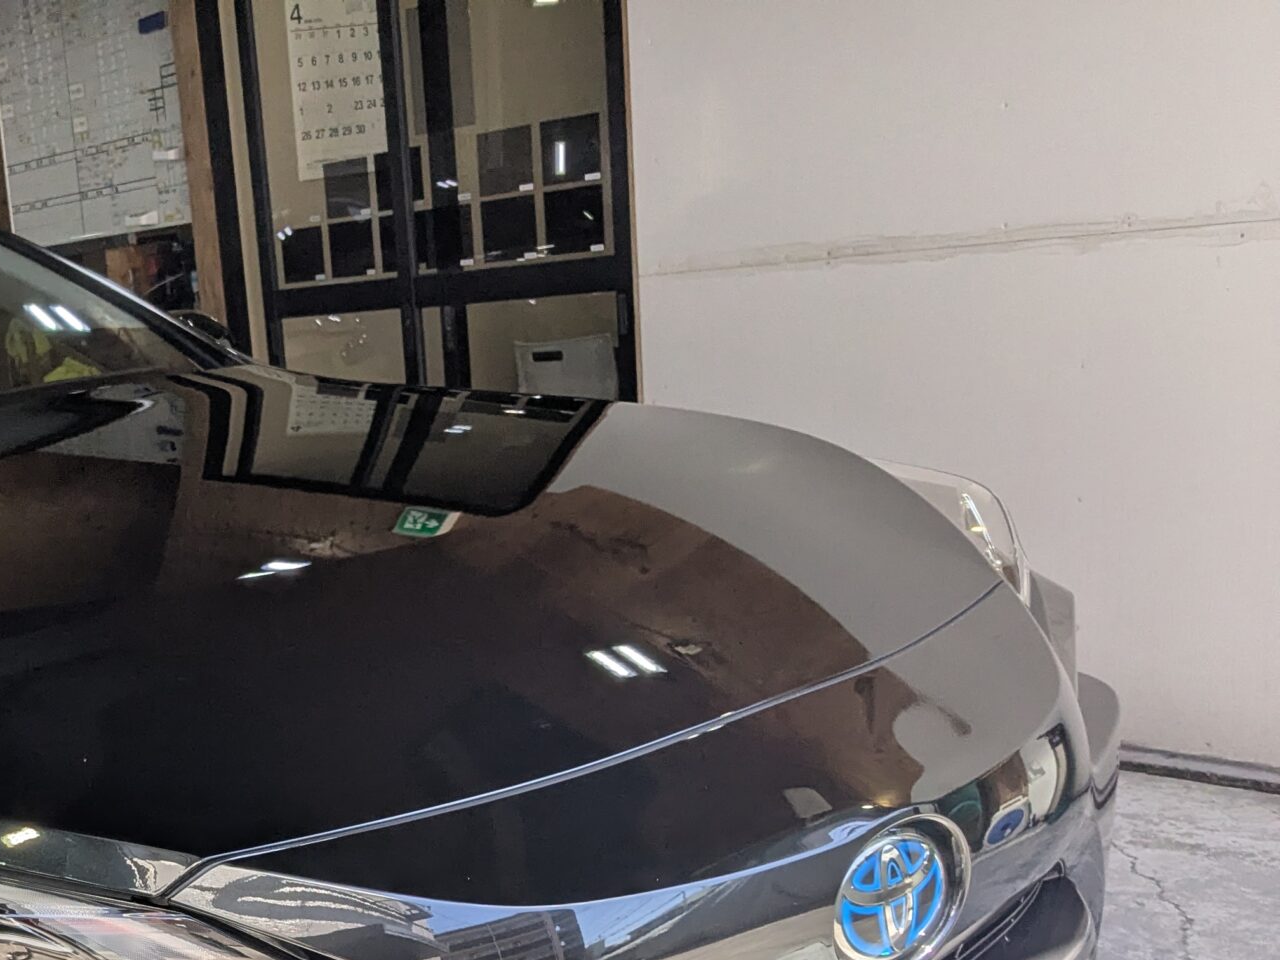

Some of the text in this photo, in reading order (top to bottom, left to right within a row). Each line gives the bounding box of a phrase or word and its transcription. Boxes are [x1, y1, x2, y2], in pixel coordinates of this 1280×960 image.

[290, 4, 302, 24] 4
[349, 28, 356, 38] 2
[363, 27, 369, 37] 3
[297, 57, 304, 68] 5
[311, 56, 317, 66] 6
[324, 54, 330, 65] 7
[338, 53, 344, 63] 8
[351, 52, 358, 62] 9
[364, 51, 373, 61] 10
[297, 81, 307, 92] 12
[311, 80, 321, 91] 13
[325, 79, 334, 89] 14
[338, 77, 348, 88] 15
[352, 76, 361, 87] 16
[365, 75, 374, 85] 17
[354, 100, 364, 111] 23
[367, 99, 377, 109] 24
[301, 124, 365, 141] 26 27 28 29 30
